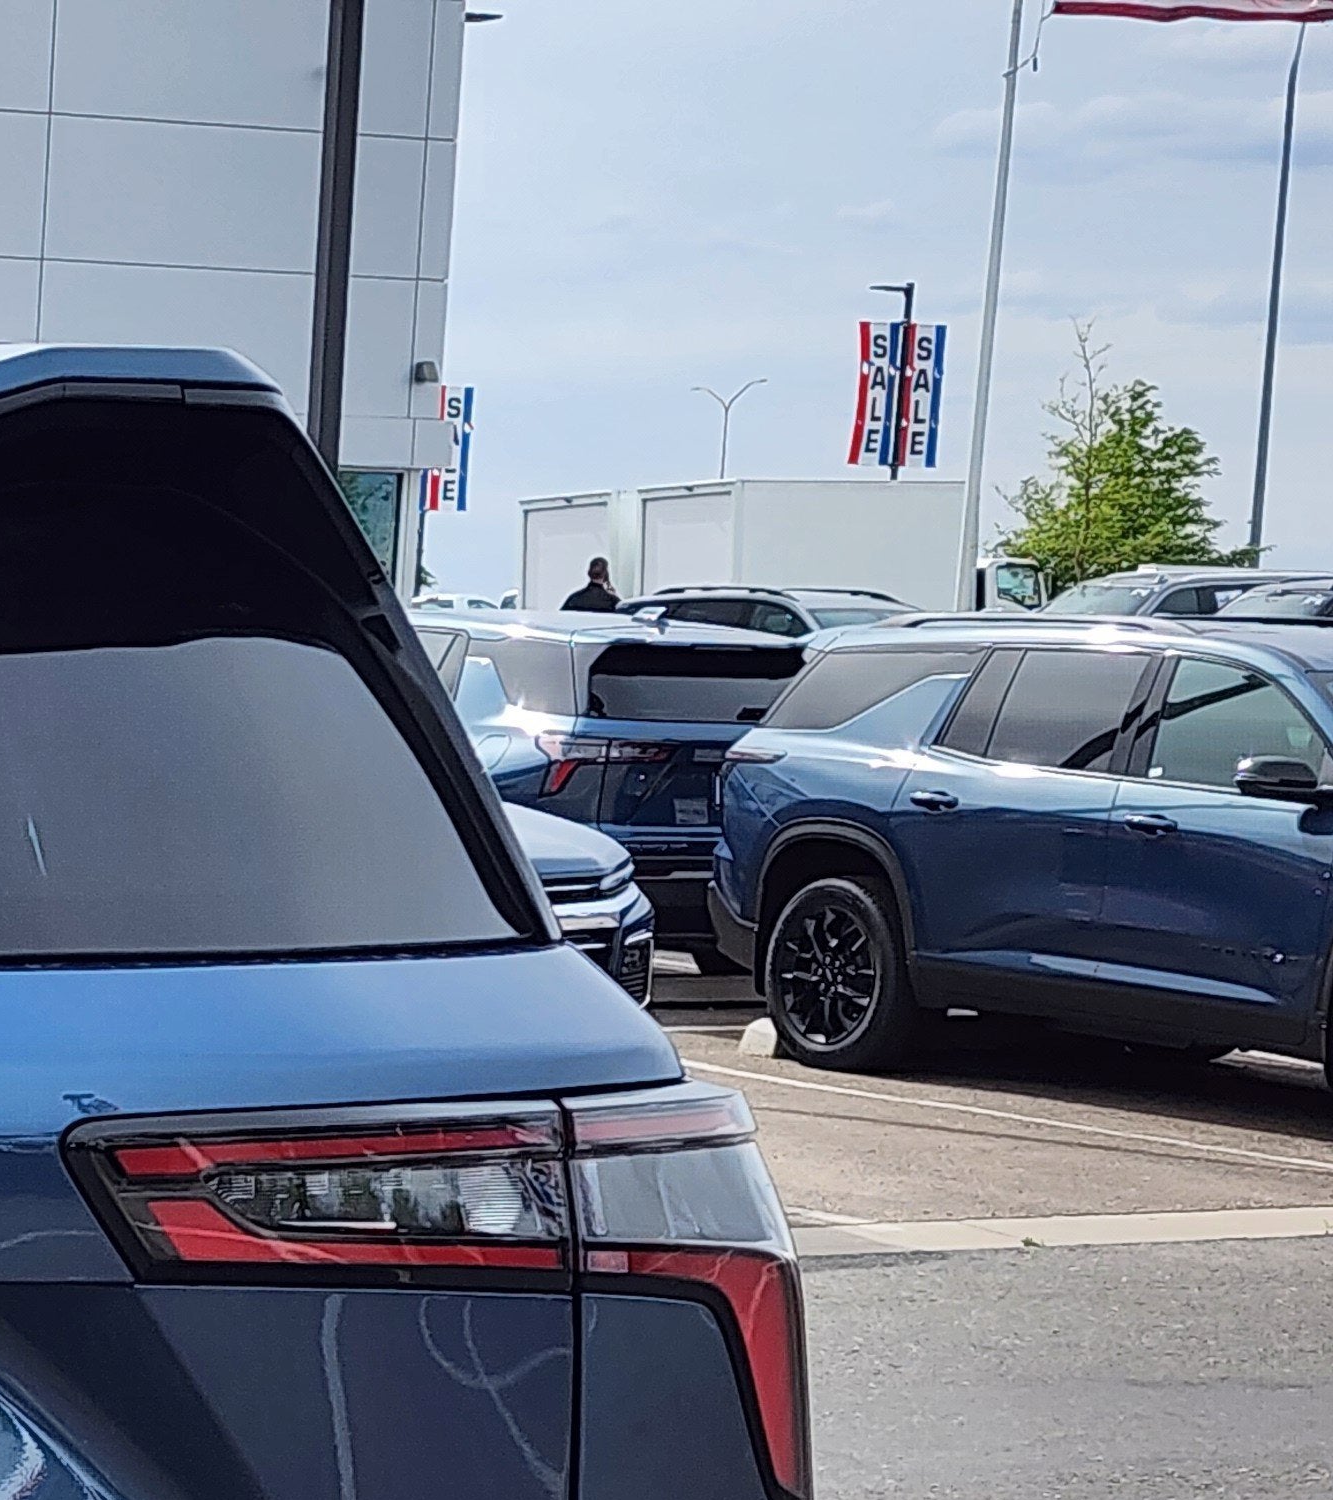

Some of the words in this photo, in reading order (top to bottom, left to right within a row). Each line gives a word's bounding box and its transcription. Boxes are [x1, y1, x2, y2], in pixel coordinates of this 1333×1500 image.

[442, 397, 462, 501] SE
[864, 333, 888, 453] SALE
[910, 336, 933, 455] SALE
